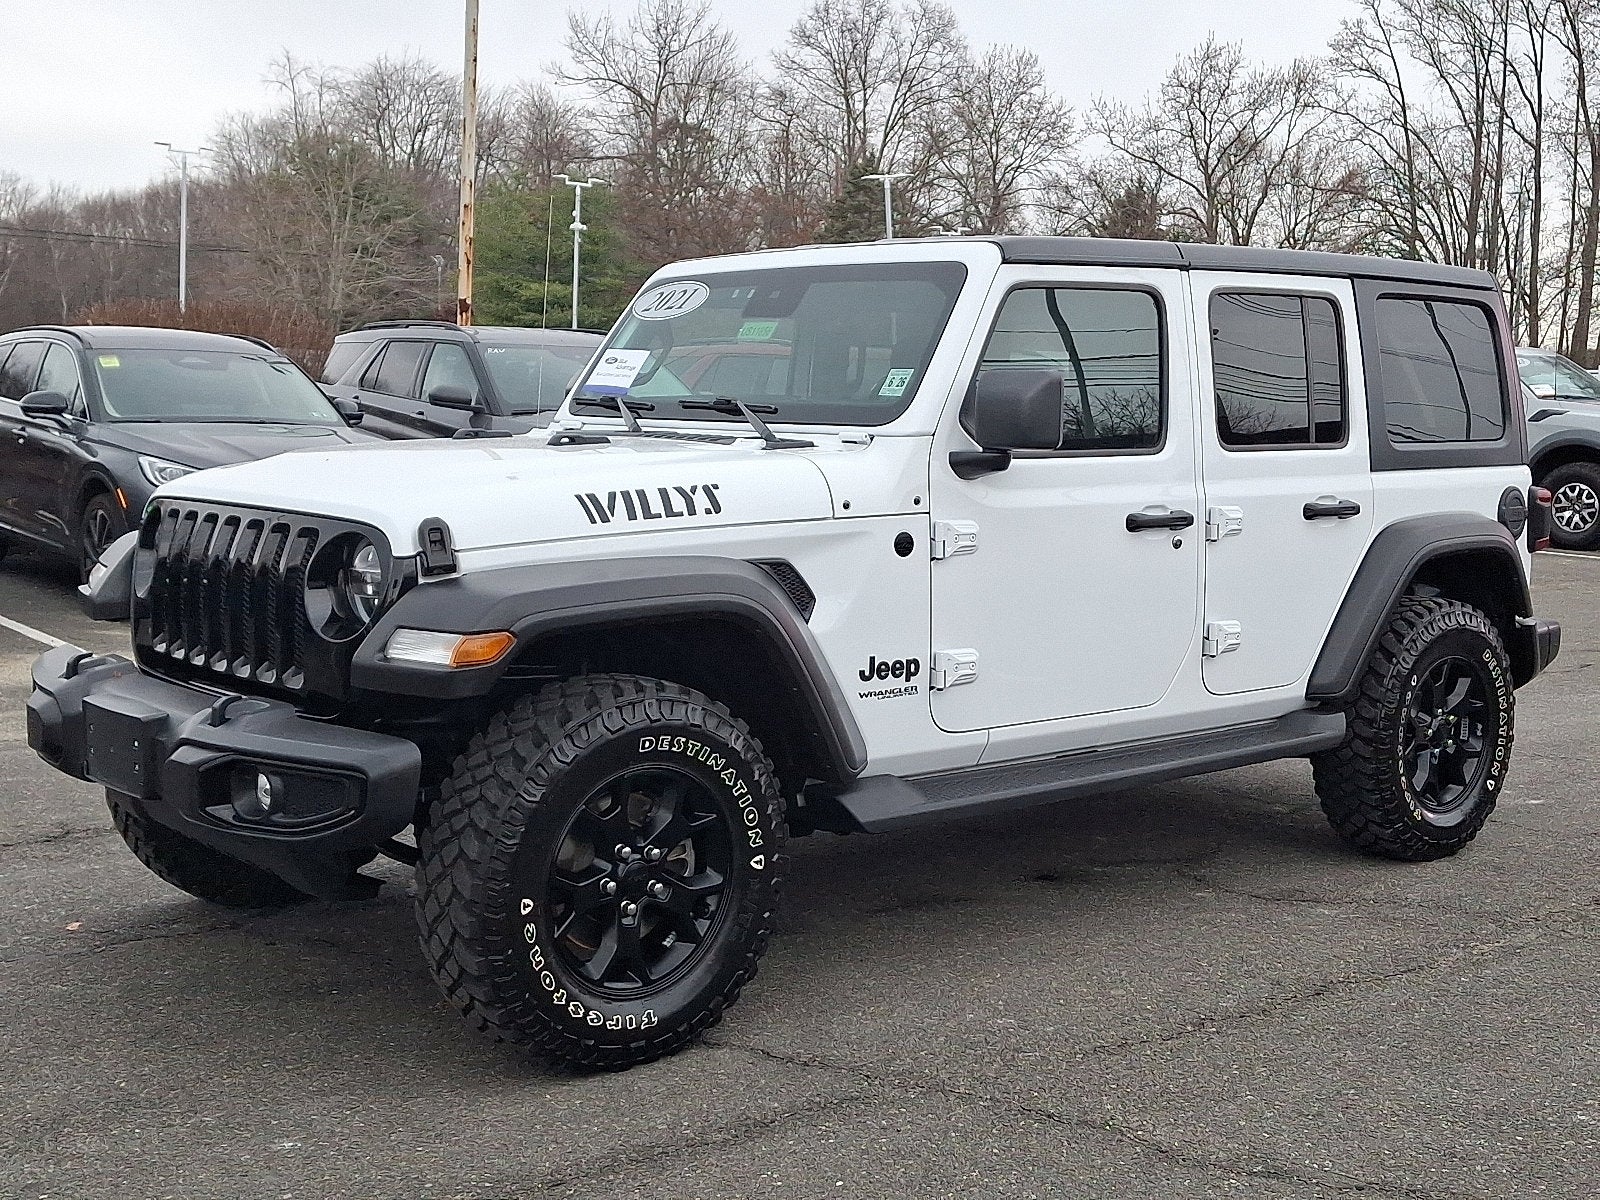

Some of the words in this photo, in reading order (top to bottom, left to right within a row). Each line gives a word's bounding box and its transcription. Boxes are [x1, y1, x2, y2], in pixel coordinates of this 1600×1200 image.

[641, 287, 700, 312] 2021
[887, 376, 896, 387] 6
[895, 376, 908, 387] 26
[574, 483, 722, 524] WILLYS
[858, 655, 920, 683] Jeep
[858, 685, 918, 699] WRANGLER
[1482, 648, 1508, 776] DESTINATION
[639, 735, 764, 848] DESTINATION
[523, 922, 658, 1030] Firestone
